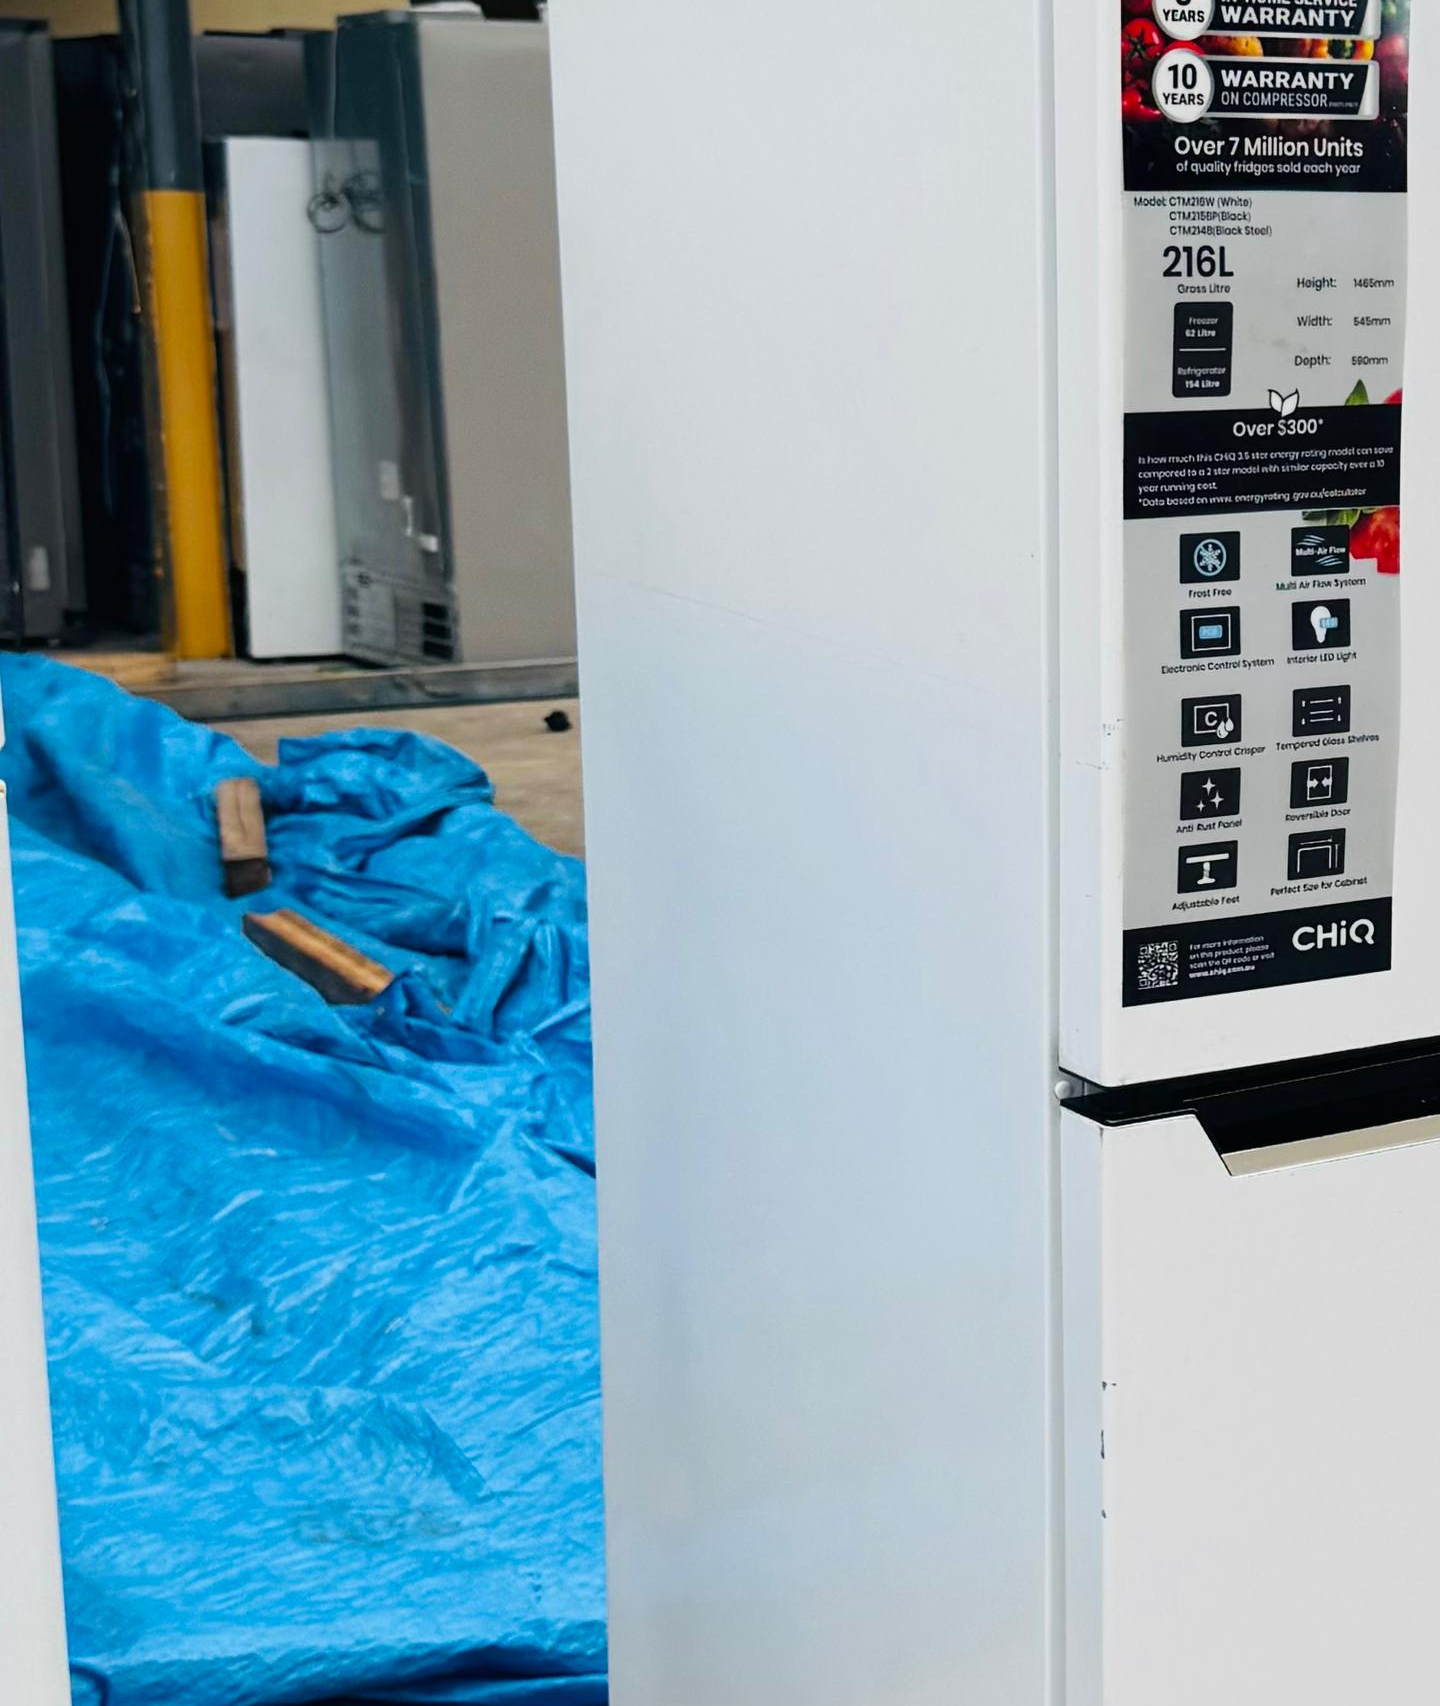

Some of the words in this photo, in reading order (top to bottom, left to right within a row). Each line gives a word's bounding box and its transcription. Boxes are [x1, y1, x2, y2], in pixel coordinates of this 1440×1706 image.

[1163, 9, 1205, 23] YEARS
[1221, 5, 1355, 27] WARRANTY
[1168, 63, 1198, 90] 10
[1221, 69, 1354, 90] WARRANTY
[1163, 92, 1205, 106] YEARS
[1221, 91, 1239, 106] ON
[1243, 91, 1328, 107] COMPRESSOR
[1174, 136, 1225, 155] Over
[1228, 137, 1240, 156] 7
[1244, 136, 1309, 157] Million
[1314, 136, 1363, 157] Units
[1176, 160, 1188, 173] of
[1191, 160, 1231, 176] quality
[1234, 161, 1274, 176] fridges
[1277, 161, 1301, 173] sold
[1303, 162, 1332, 174] each
[1335, 164, 1361, 177] year
[1217, 196, 1253, 208] (White)
[1245, 225, 1272, 237] Steel)
[1162, 245, 1234, 277] 216L
[1177, 284, 1207, 294] Gross
[1209, 283, 1231, 294] Litre
[1297, 277, 1337, 291] Height:
[1188, 316, 1219, 325] Freezer
[1297, 315, 1333, 326] Width:
[1353, 316, 1391, 326] 545mm
[1197, 328, 1216, 337] Litre
[1294, 354, 1331, 368] Depth:
[1351, 356, 1389, 366] 590mm
[1177, 366, 1226, 377] Refrigerator
[1185, 380, 1199, 388] 154
[1201, 379, 1220, 388] Litre
[1233, 421, 1274, 437] Over
[1147, 455, 1167, 464] how
[1168, 454, 1195, 463] much
[1196, 453, 1212, 462] this
[1270, 451, 1299, 461] energy
[1301, 449, 1327, 459] rating
[1328, 447, 1355, 456] model
[1356, 447, 1372, 455] can
[1138, 468, 1186, 480] compared
[1187, 468, 1196, 476] to
[1206, 467, 1212, 476] 2
[1232, 464, 1259, 474] model
[1311, 461, 1348, 473] capacity
[1138, 484, 1159, 495] year
[1160, 482, 1195, 493] running
[1166, 496, 1194, 505] based
[1196, 496, 1208, 504] on
[1299, 580, 1310, 589] Air
[1333, 577, 1366, 589] System
[1188, 588, 1211, 598] Frost
[1212, 588, 1232, 597] Free
[1287, 654, 1318, 664] Interior
[1319, 653, 1335, 662] LED
[1336, 651, 1357, 663] Light
[1161, 663, 1205, 674] Electronic
[1207, 660, 1241, 671] Control
[1242, 657, 1275, 670] System
[1204, 711, 1218, 726] C
[1275, 738, 1320, 751] Tempered
[1322, 736, 1346, 746] Glass
[1156, 751, 1197, 763] Humidity
[1199, 748, 1232, 759] Control
[1234, 745, 1266, 756] Crisper
[1285, 809, 1328, 821] Reversible
[1330, 808, 1351, 817] Door
[1176, 824, 1194, 833] Anti
[1196, 822, 1216, 831] Rust
[1218, 819, 1243, 829] Panel
[1270, 885, 1301, 896] Perfect
[1334, 876, 1368, 888] Cabinet
[1172, 898, 1219, 911] Adjustable
[1221, 895, 1241, 905] Feet
[1292, 918, 1375, 951] CHiQ
